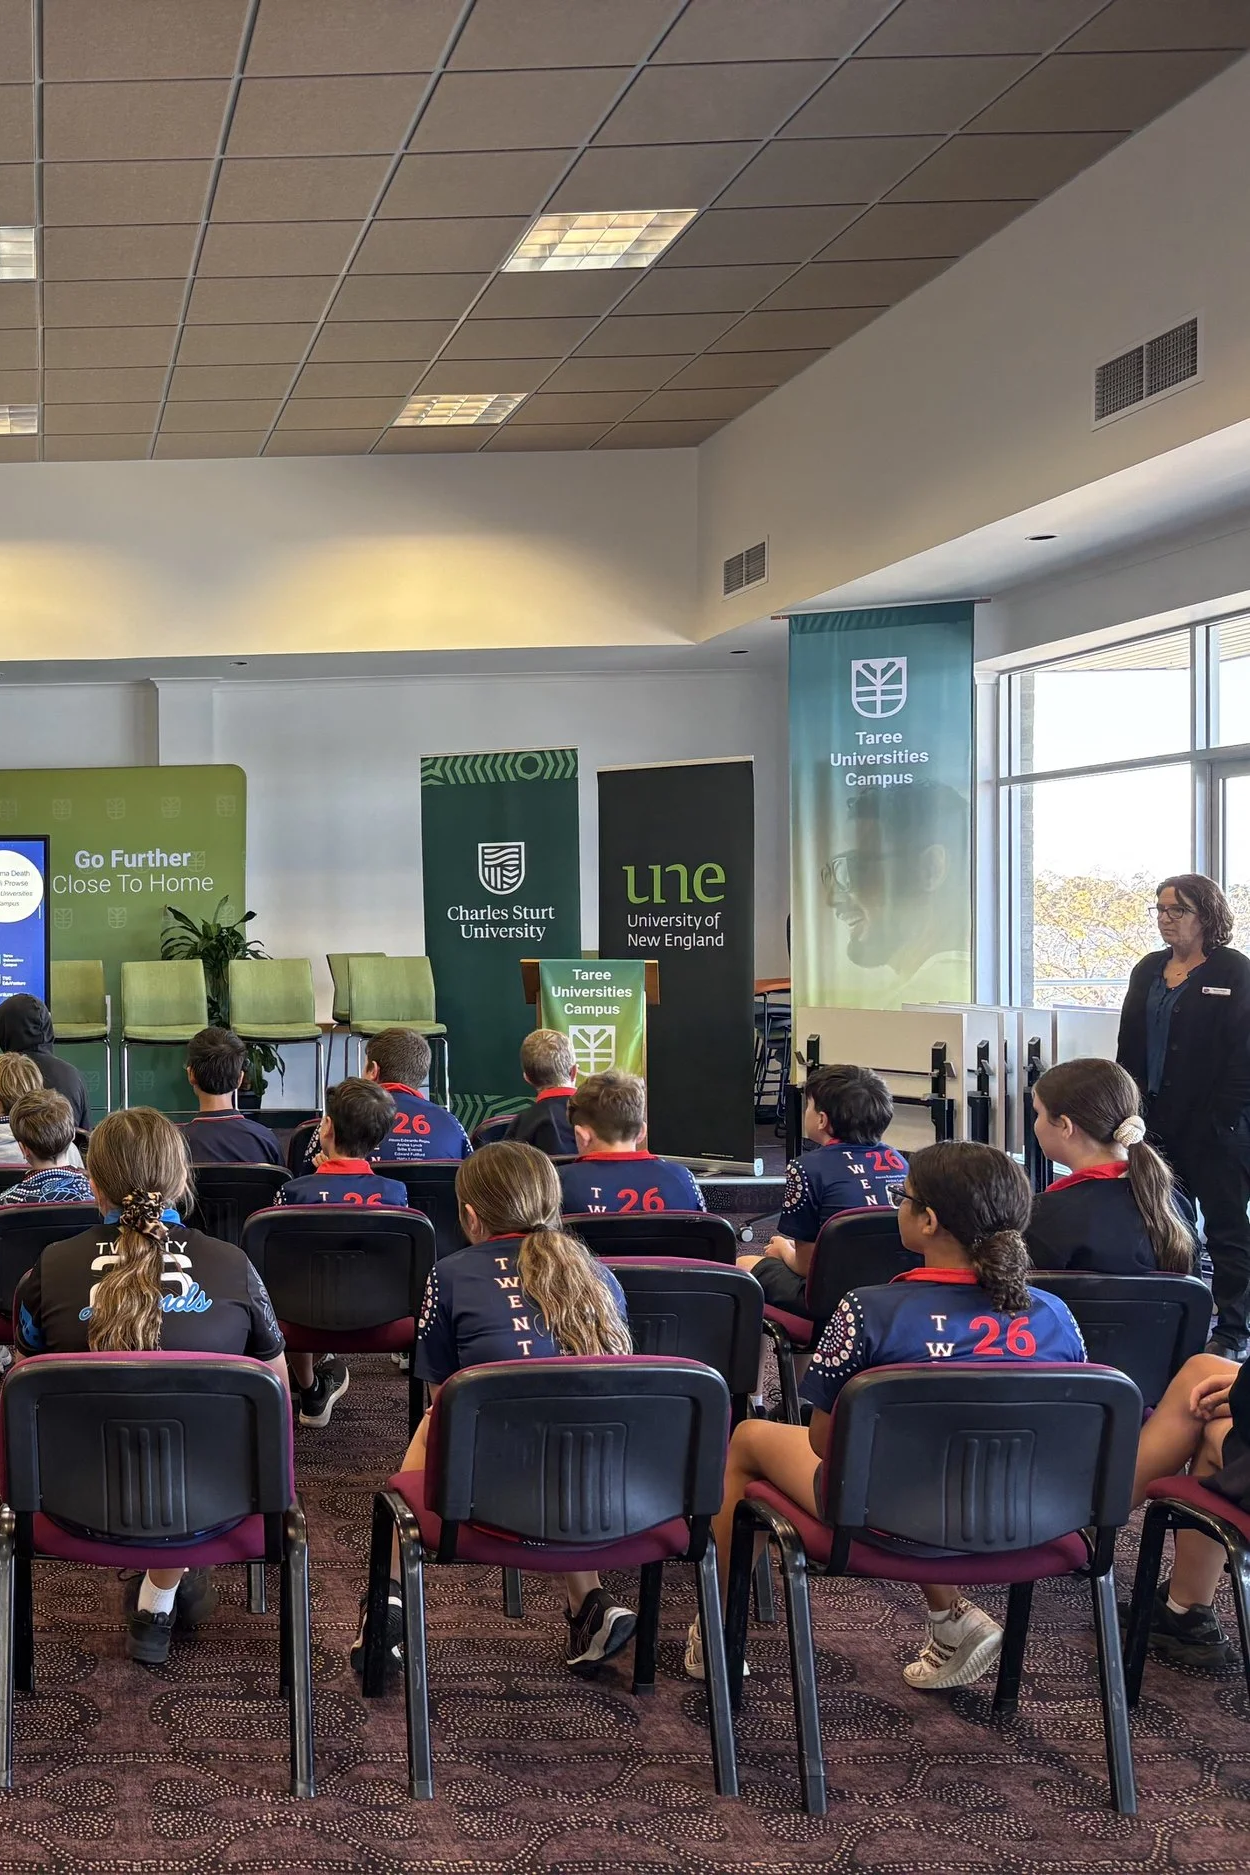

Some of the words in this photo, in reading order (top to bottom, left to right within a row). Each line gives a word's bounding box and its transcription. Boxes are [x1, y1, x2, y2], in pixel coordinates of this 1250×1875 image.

[855, 731, 903, 745] Taree
[830, 750, 929, 767] Universities
[845, 772, 913, 788] Campus
[74, 850, 105, 868] Go
[111, 848, 191, 868] Further
[52, 874, 111, 894] Close
[117, 874, 143, 893] To
[150, 873, 214, 892] Home
[622, 862, 726, 904] une
[447, 904, 509, 921] Charles
[512, 904, 555, 920] Sturt
[627, 912, 702, 931] University
[704, 912, 722, 930] of
[460, 922, 547, 942] University
[627, 933, 661, 947] New
[664, 932, 725, 951] England
[572, 969, 612, 980] Taree
[551, 985, 633, 998] Universities
[564, 1002, 620, 1017] Campus
[392, 1111, 431, 1135] 26
[865, 1149, 905, 1171] 26
[617, 1186, 665, 1214] 26
[969, 1315, 1037, 1357] 26
